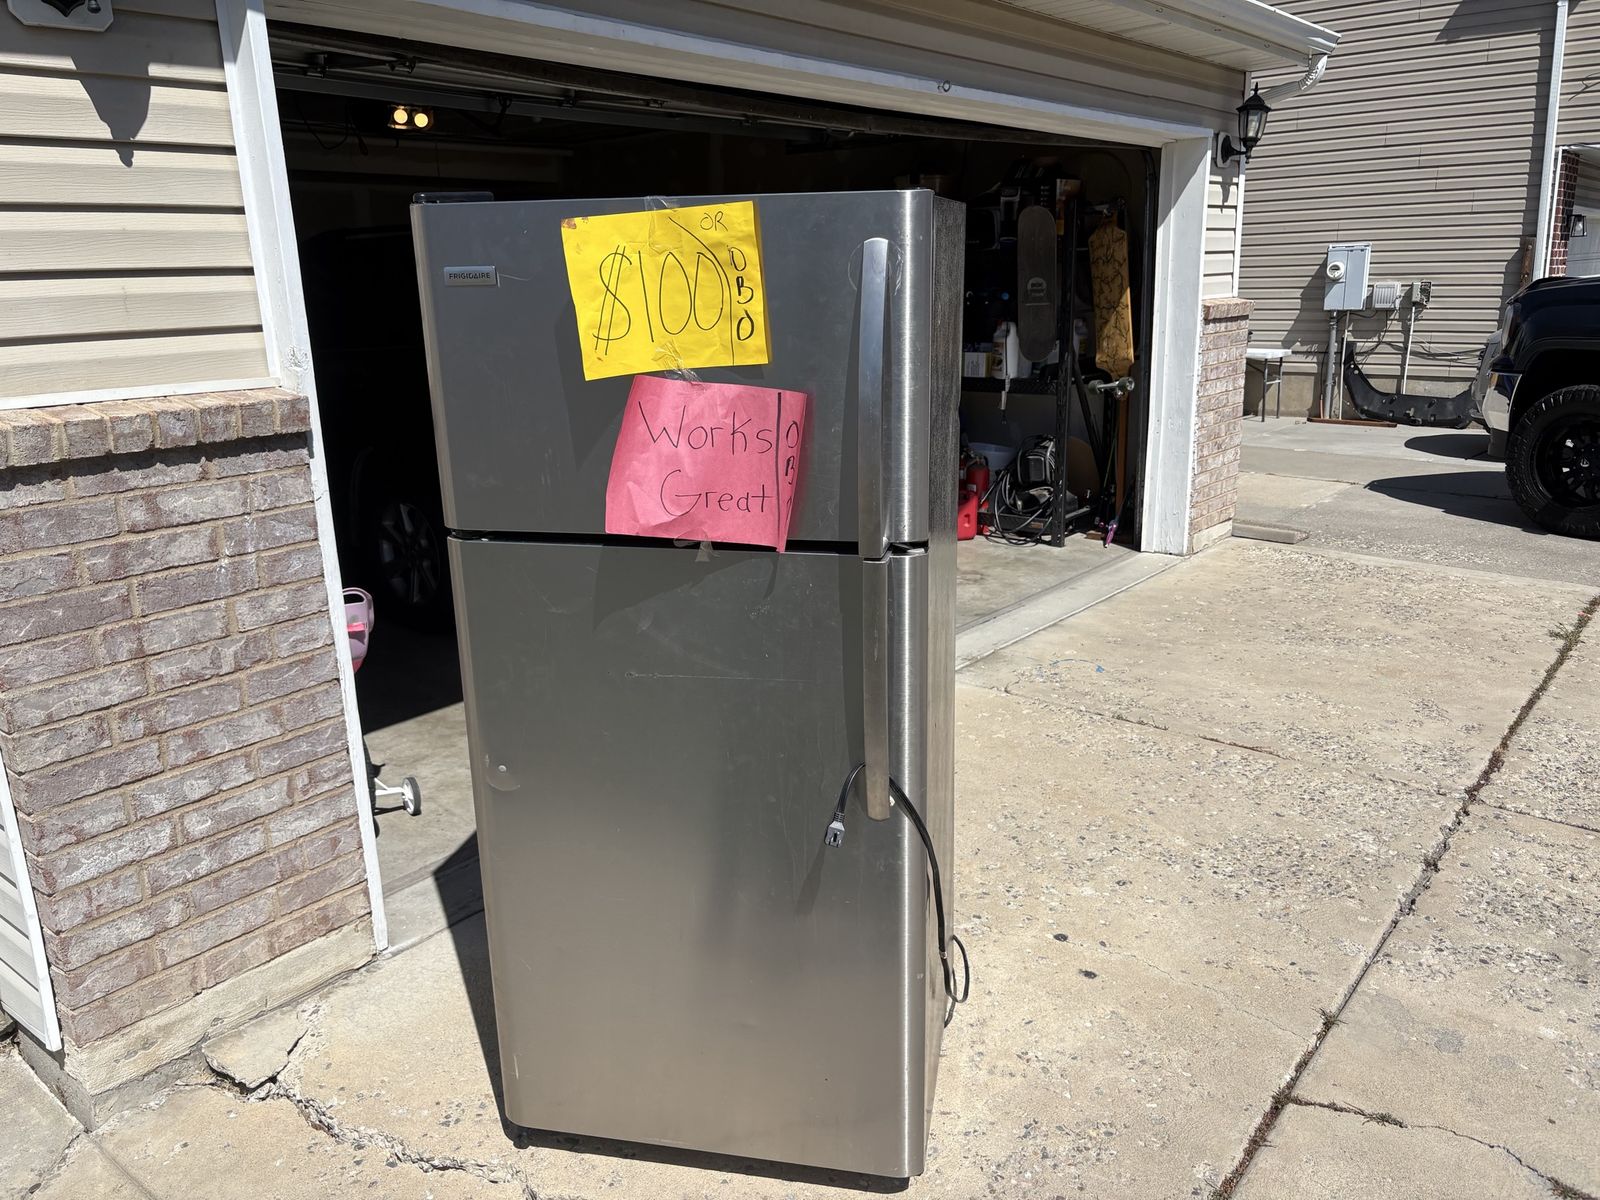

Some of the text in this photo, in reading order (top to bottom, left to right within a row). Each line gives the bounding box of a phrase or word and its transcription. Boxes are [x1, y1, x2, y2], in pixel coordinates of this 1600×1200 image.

[700, 210, 728, 232] OR
[448, 271, 491, 280] FRIGIDAIRE
[592, 245, 724, 356] $100
[729, 245, 755, 342] OBO
[638, 401, 773, 455] Works
[659, 469, 774, 517] Great
